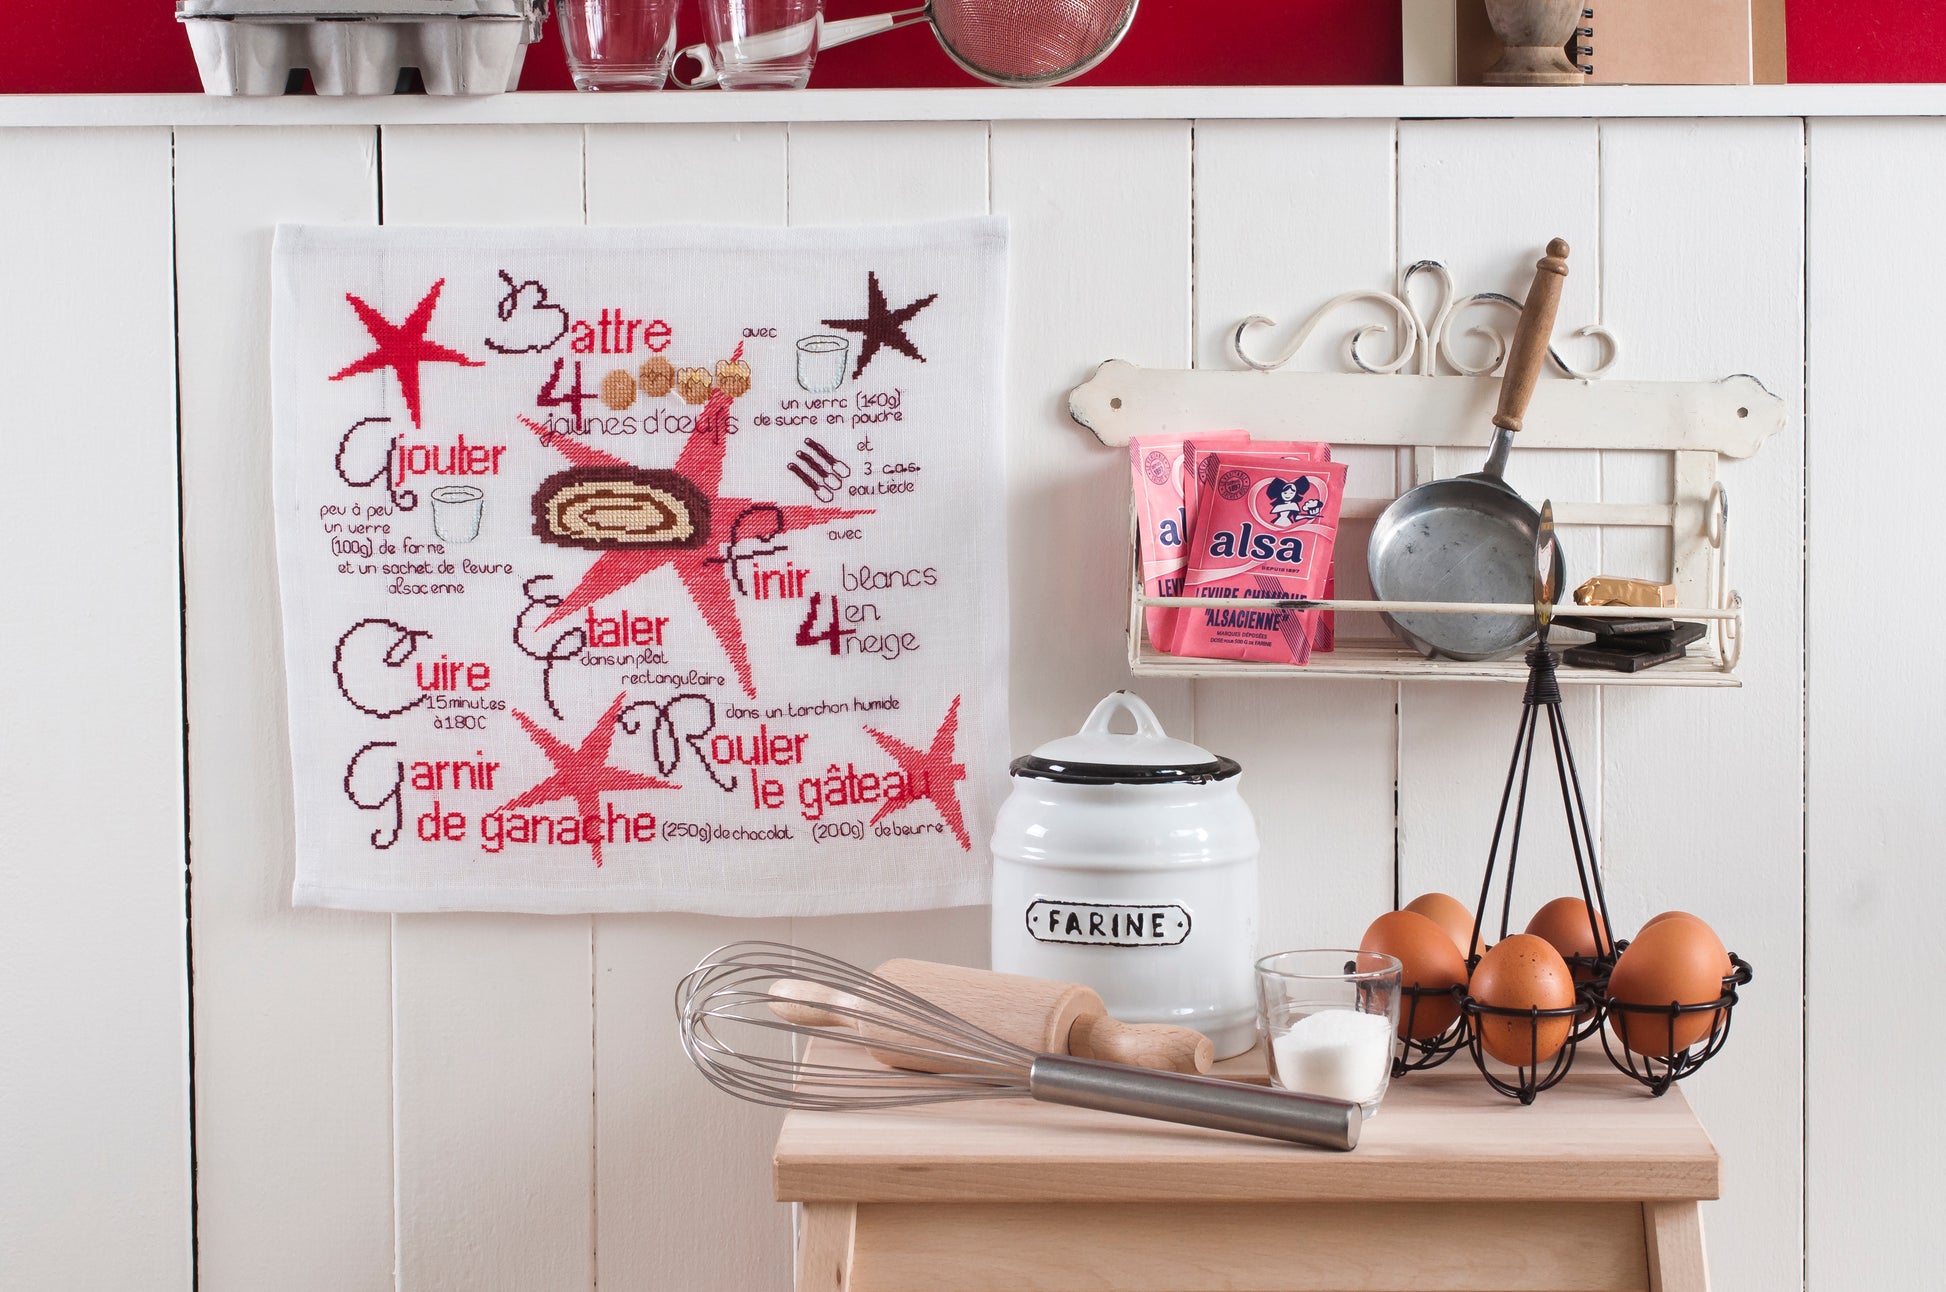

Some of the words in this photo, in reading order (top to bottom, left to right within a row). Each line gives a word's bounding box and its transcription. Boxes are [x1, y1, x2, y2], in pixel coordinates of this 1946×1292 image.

[485, 269, 672, 354] Battre
[742, 326, 777, 338] avec
[537, 357, 598, 431] 4
[781, 399, 799, 410] un
[856, 388, 901, 411] (140g)
[539, 412, 638, 447] jaunes
[753, 413, 771, 426] de
[775, 414, 818, 426] sucre
[826, 414, 844, 424] en
[851, 409, 903, 428] poudre
[857, 436, 873, 451] et
[336, 417, 507, 511] Ajouter
[864, 461, 872, 475] 3
[849, 485, 875, 496] eau
[878, 478, 914, 495] tiède
[319, 505, 346, 520] peu
[352, 502, 361, 516] à
[367, 505, 394, 521] peu
[324, 523, 343, 534] un
[348, 523, 391, 534] verre
[828, 529, 863, 541] avec
[331, 536, 373, 558] (100g)
[379, 539, 396, 554] de
[703, 505, 811, 601] Finir
[1208, 521, 1303, 564] alsa
[338, 560, 354, 574] et
[359, 564, 377, 574] un
[382, 560, 433, 574] sachet
[437, 560, 455, 574] de
[462, 558, 513, 574] levure
[842, 563, 938, 591] blancs
[796, 592, 857, 655] 4
[844, 604, 881, 622] en
[846, 632, 920, 660] neige
[333, 618, 491, 719] Cuire
[580, 651, 615, 666] dans
[616, 654, 634, 666] un
[636, 647, 669, 669] plat
[621, 669, 725, 689] rectangulaire
[426, 694, 448, 709] 15
[449, 696, 506, 711] minutes
[726, 703, 760, 720] dans
[765, 706, 783, 718] un
[788, 701, 849, 717] torchon
[853, 697, 900, 712] humide
[433, 715, 443, 729] à
[617, 693, 809, 792] Rouler
[751, 768, 784, 809] le
[799, 763, 931, 820] gâteau
[417, 801, 466, 841] de
[481, 802, 656, 853] ganache
[662, 821, 711, 843] (250g)
[713, 824, 730, 838] de
[732, 825, 794, 840] chocolat
[812, 819, 865, 843] (200g)
[874, 824, 892, 837] de
[892, 821, 944, 836] beurre
[1049, 909, 1166, 938] FARINE
